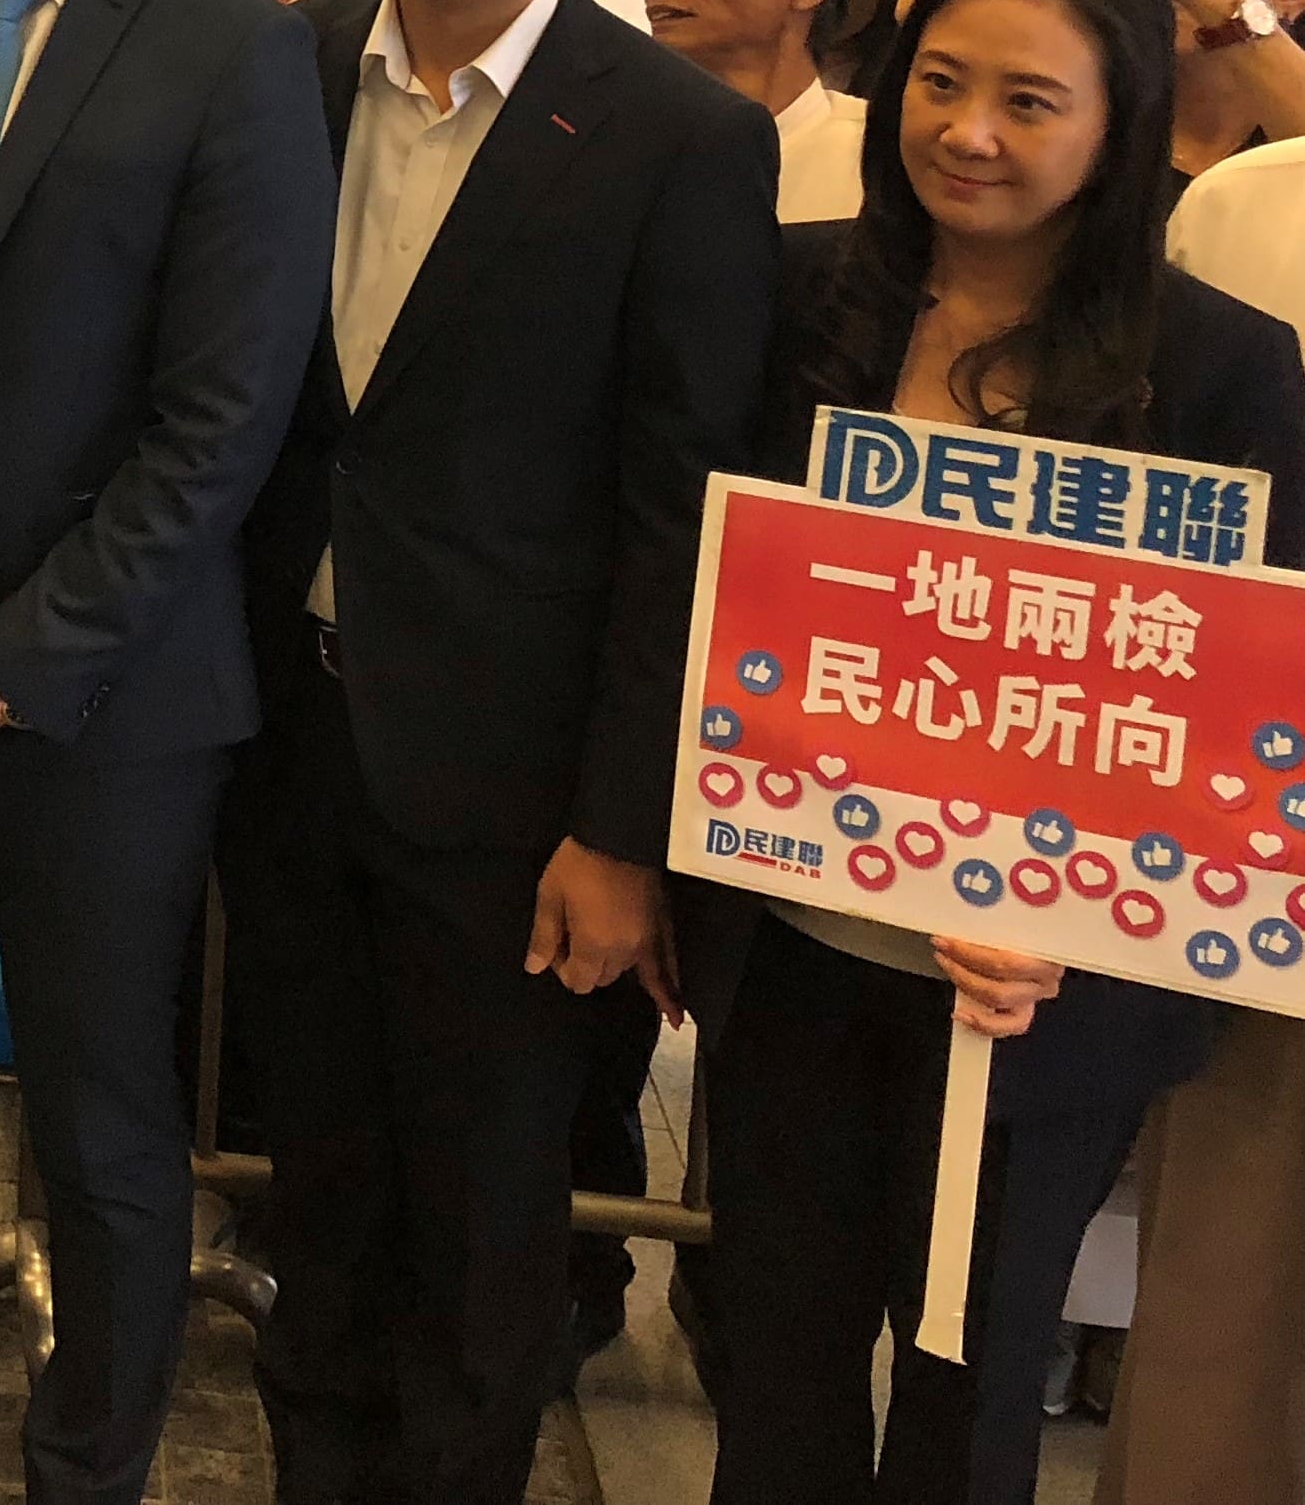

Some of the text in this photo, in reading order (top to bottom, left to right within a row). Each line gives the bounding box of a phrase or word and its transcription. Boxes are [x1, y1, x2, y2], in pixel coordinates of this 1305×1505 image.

[921, 433, 1249, 566] 民建聯
[809, 549, 1202, 680] 一地兩檢
[801, 636, 1187, 786] 民心所向
[745, 828, 823, 867] 民建聯
[780, 862, 821, 879] DAB
